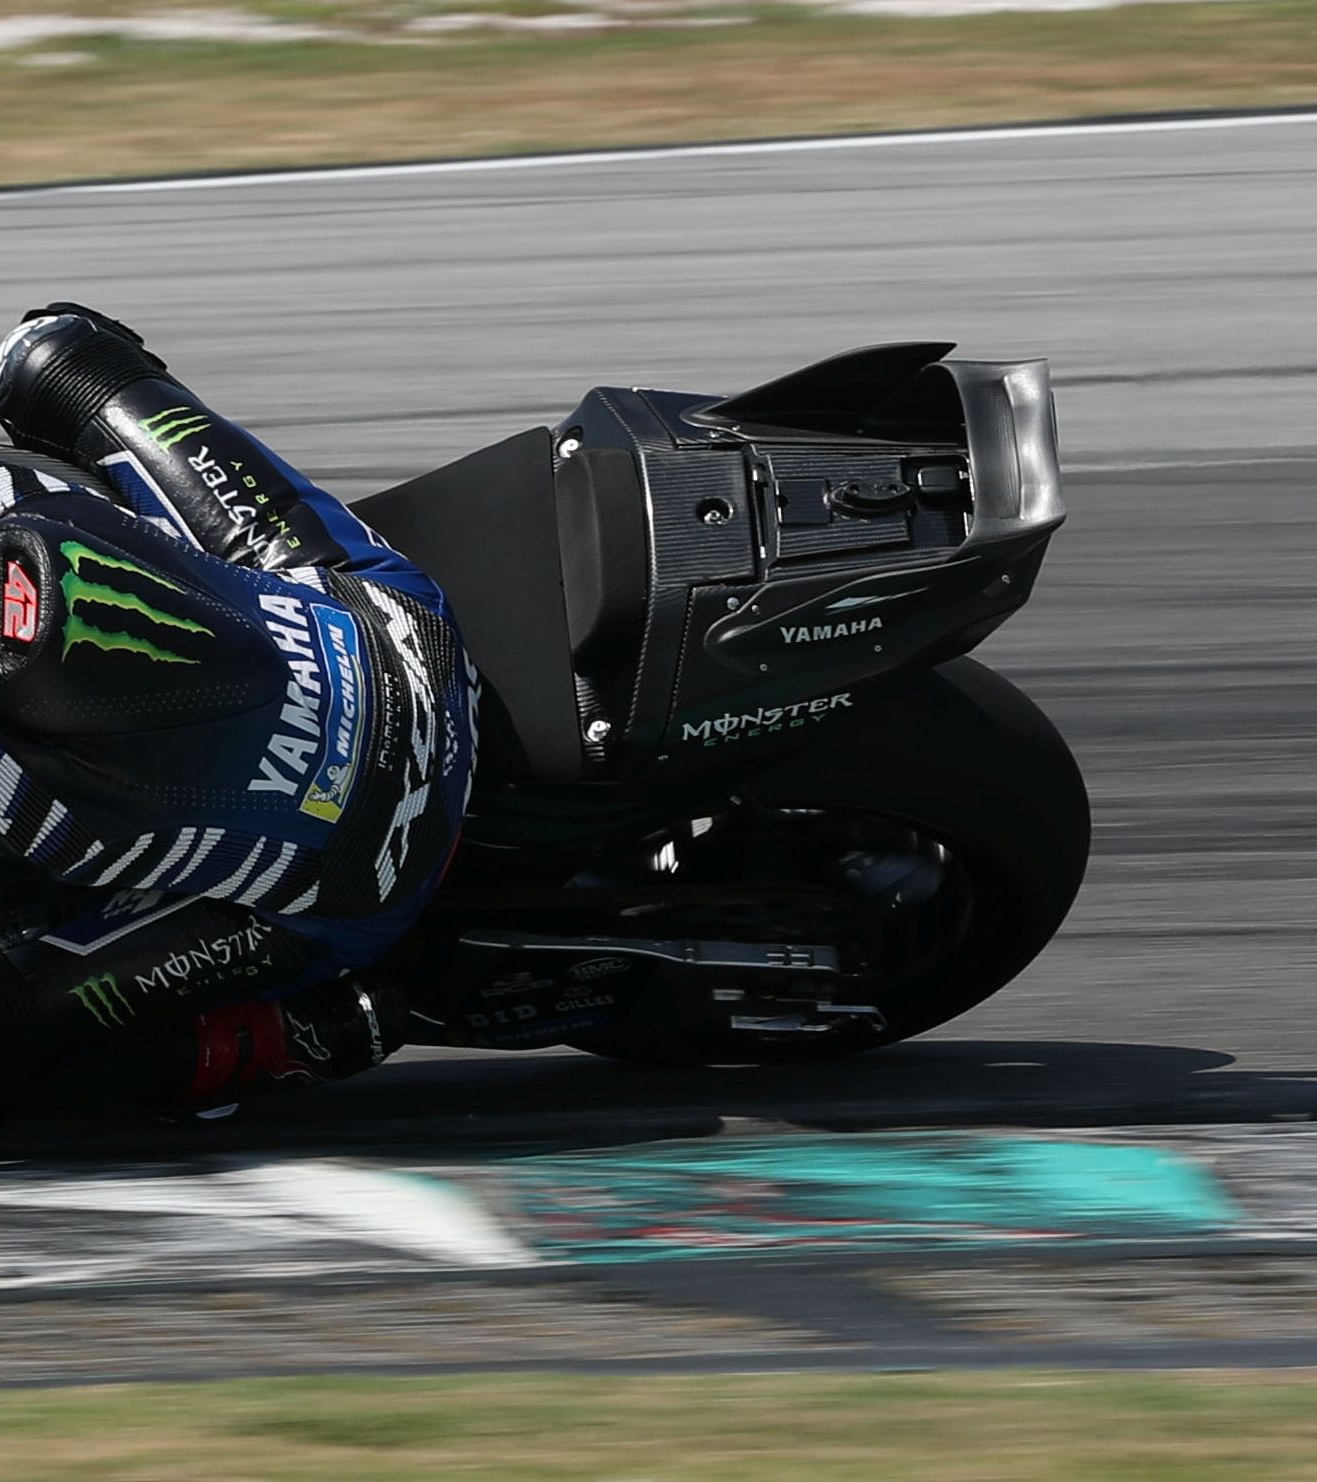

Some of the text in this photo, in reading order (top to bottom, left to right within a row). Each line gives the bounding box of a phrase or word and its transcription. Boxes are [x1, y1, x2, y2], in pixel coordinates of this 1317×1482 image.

[3, 560, 40, 643] 42
[780, 616, 883, 644] YAMAHA
[247, 593, 322, 797] YAMAHA
[335, 625, 356, 758] MICHELIN
[682, 691, 854, 742] MONSTER
